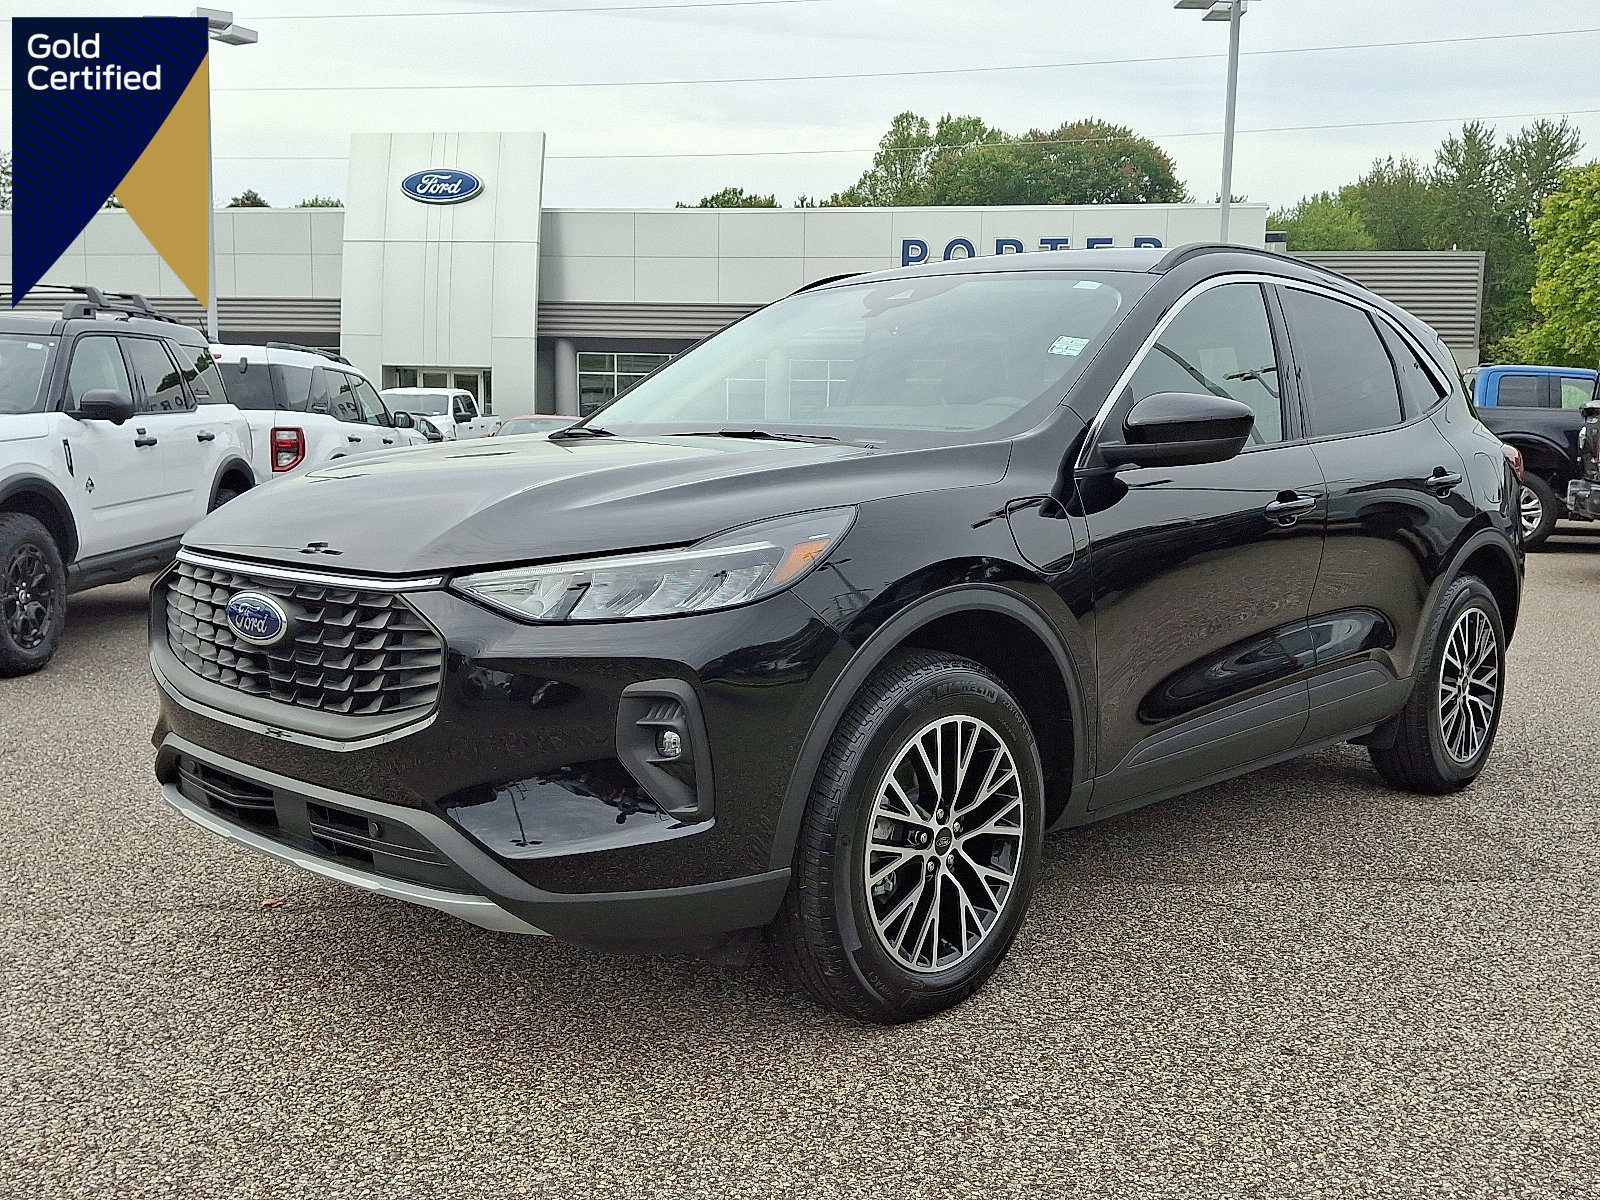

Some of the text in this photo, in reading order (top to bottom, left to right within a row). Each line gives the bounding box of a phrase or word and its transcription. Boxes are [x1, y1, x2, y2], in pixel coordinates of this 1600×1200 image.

[416, 174, 463, 194] Ford
[900, 237, 1164, 267] POR
[235, 602, 268, 633] Ford
